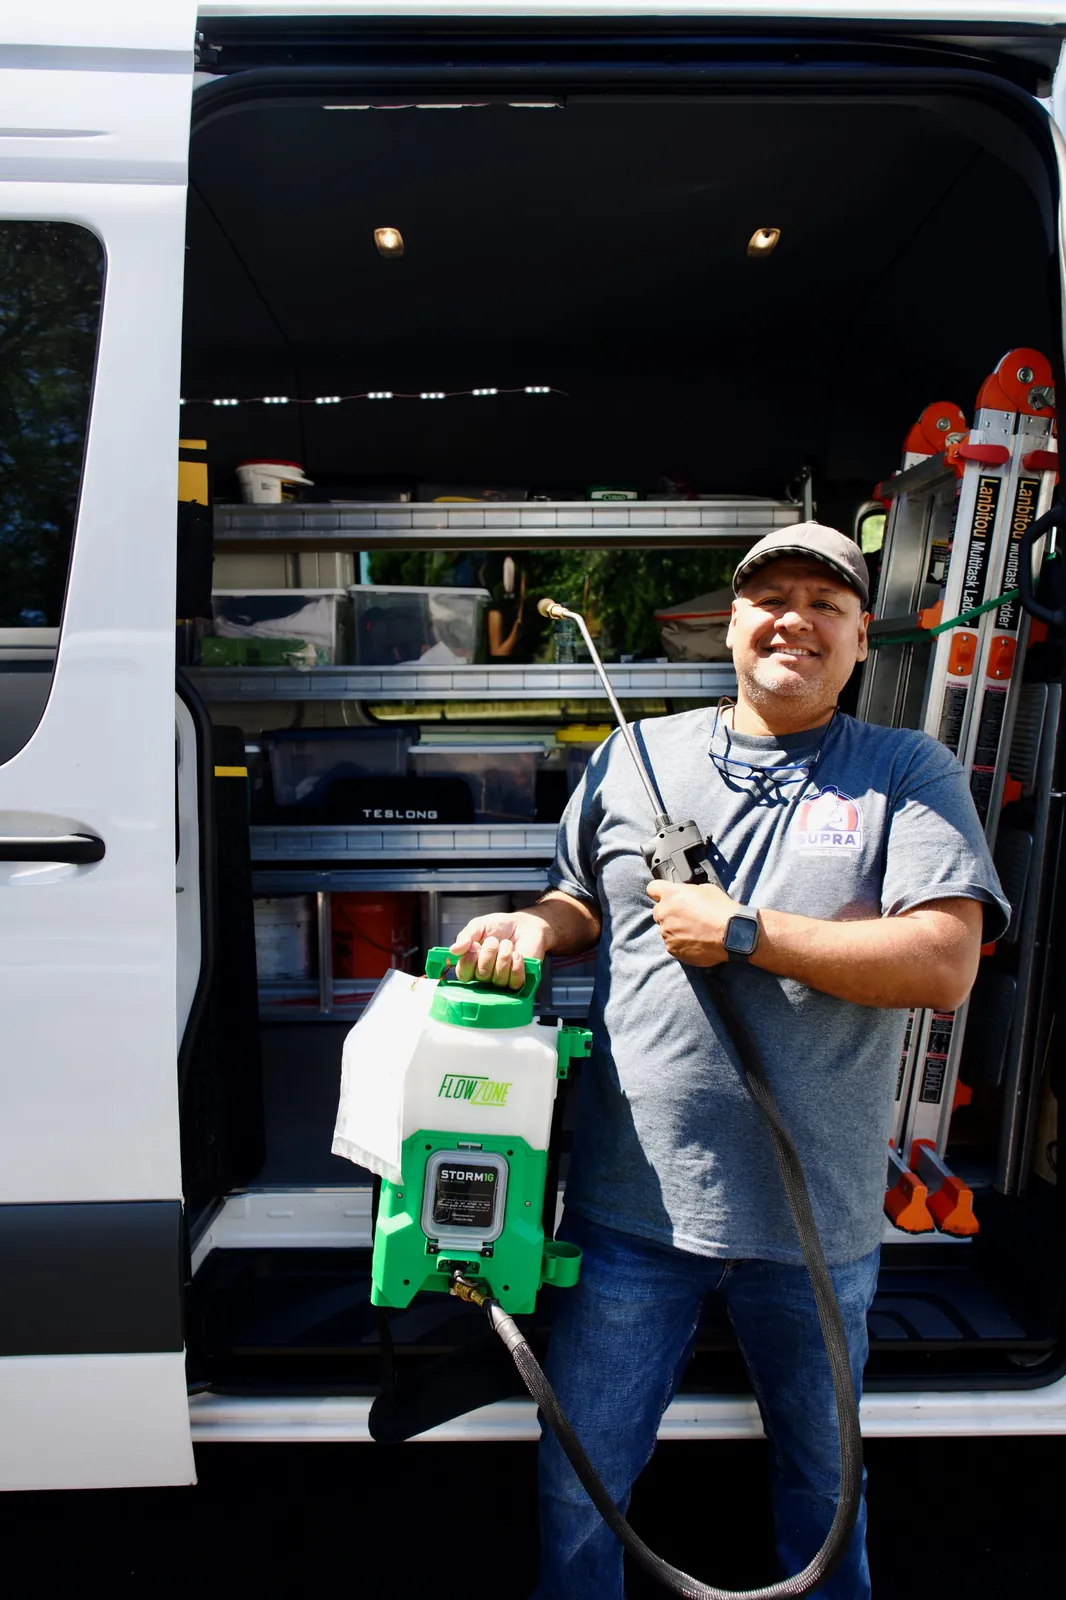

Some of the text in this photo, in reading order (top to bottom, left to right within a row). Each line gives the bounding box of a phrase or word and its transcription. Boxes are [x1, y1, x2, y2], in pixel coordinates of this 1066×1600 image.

[1012, 480, 1039, 539] Lanbitou
[960, 478, 999, 626] Lanbitou Multitask Ladr
[362, 809, 438, 819] TESLONG
[799, 834, 856, 845] SUPRA
